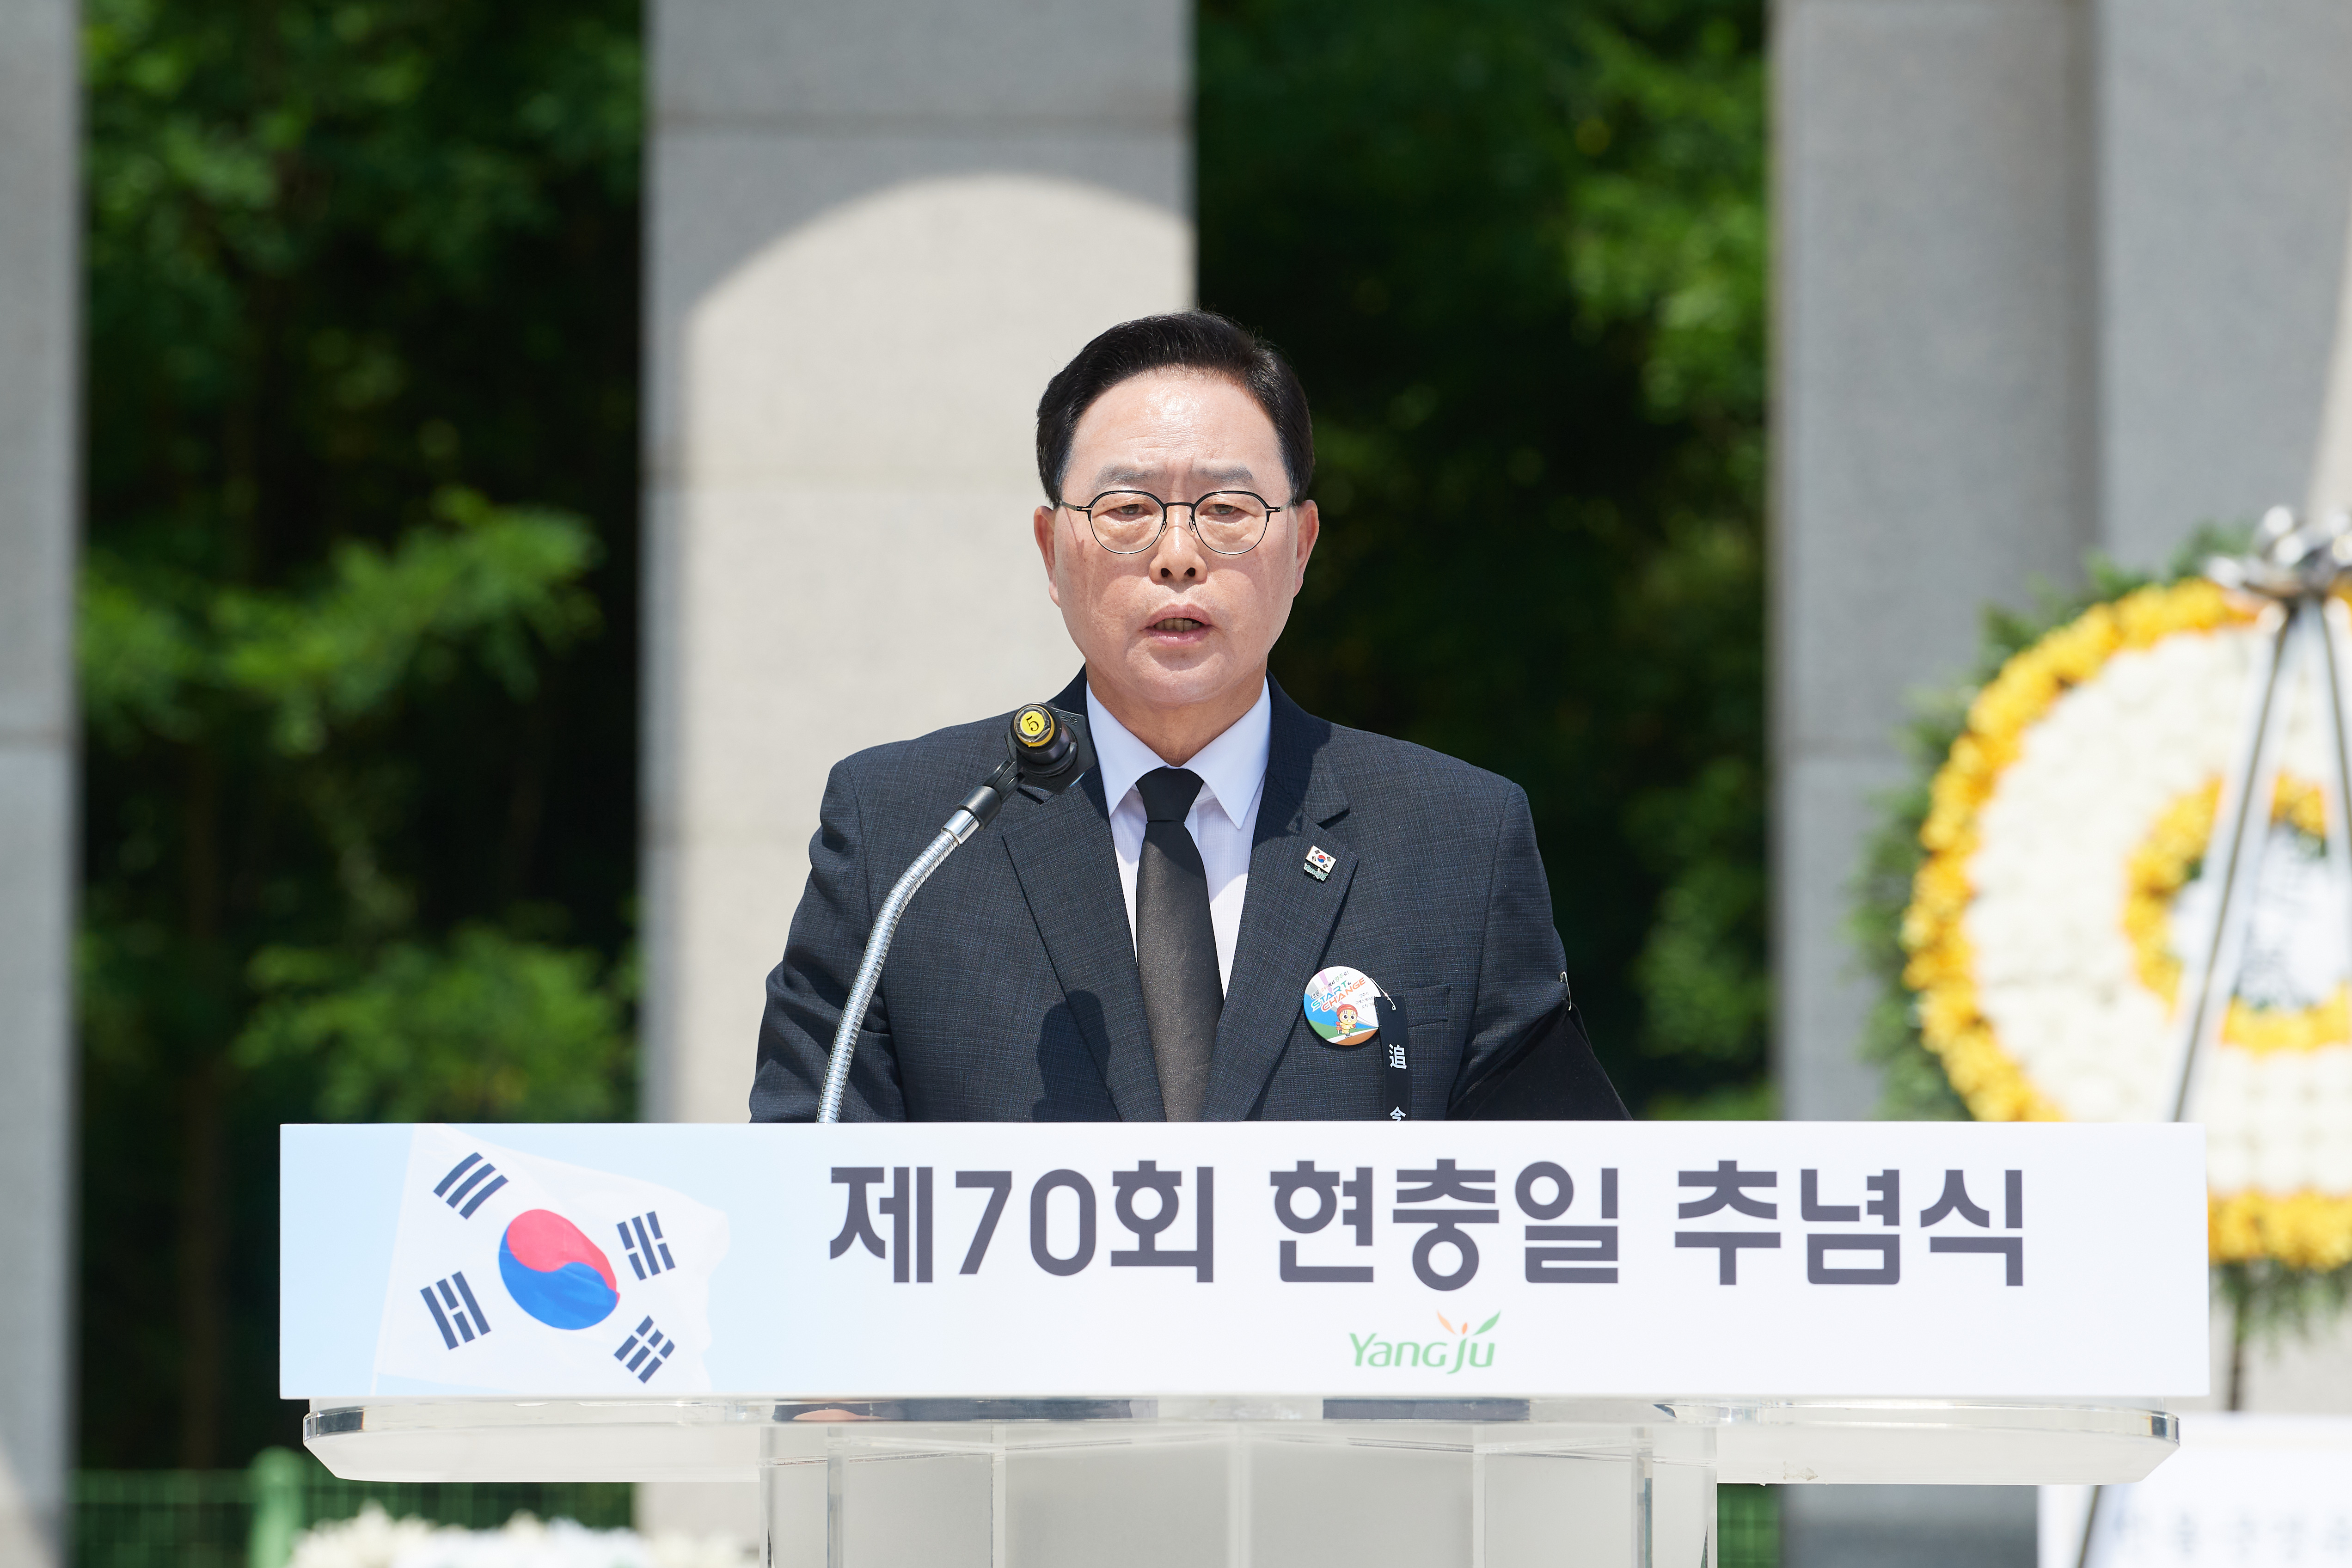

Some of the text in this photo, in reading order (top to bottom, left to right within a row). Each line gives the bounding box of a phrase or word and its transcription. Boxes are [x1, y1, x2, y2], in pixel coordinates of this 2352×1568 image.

[1026, 715, 1039, 732] 5
[1312, 980, 1347, 1010] START
[1322, 977, 1366, 1011] CHANGE
[831, 1159, 2023, 1291] 제70회 현충일 추념식
[1349, 1321, 1495, 1375] Yangju
